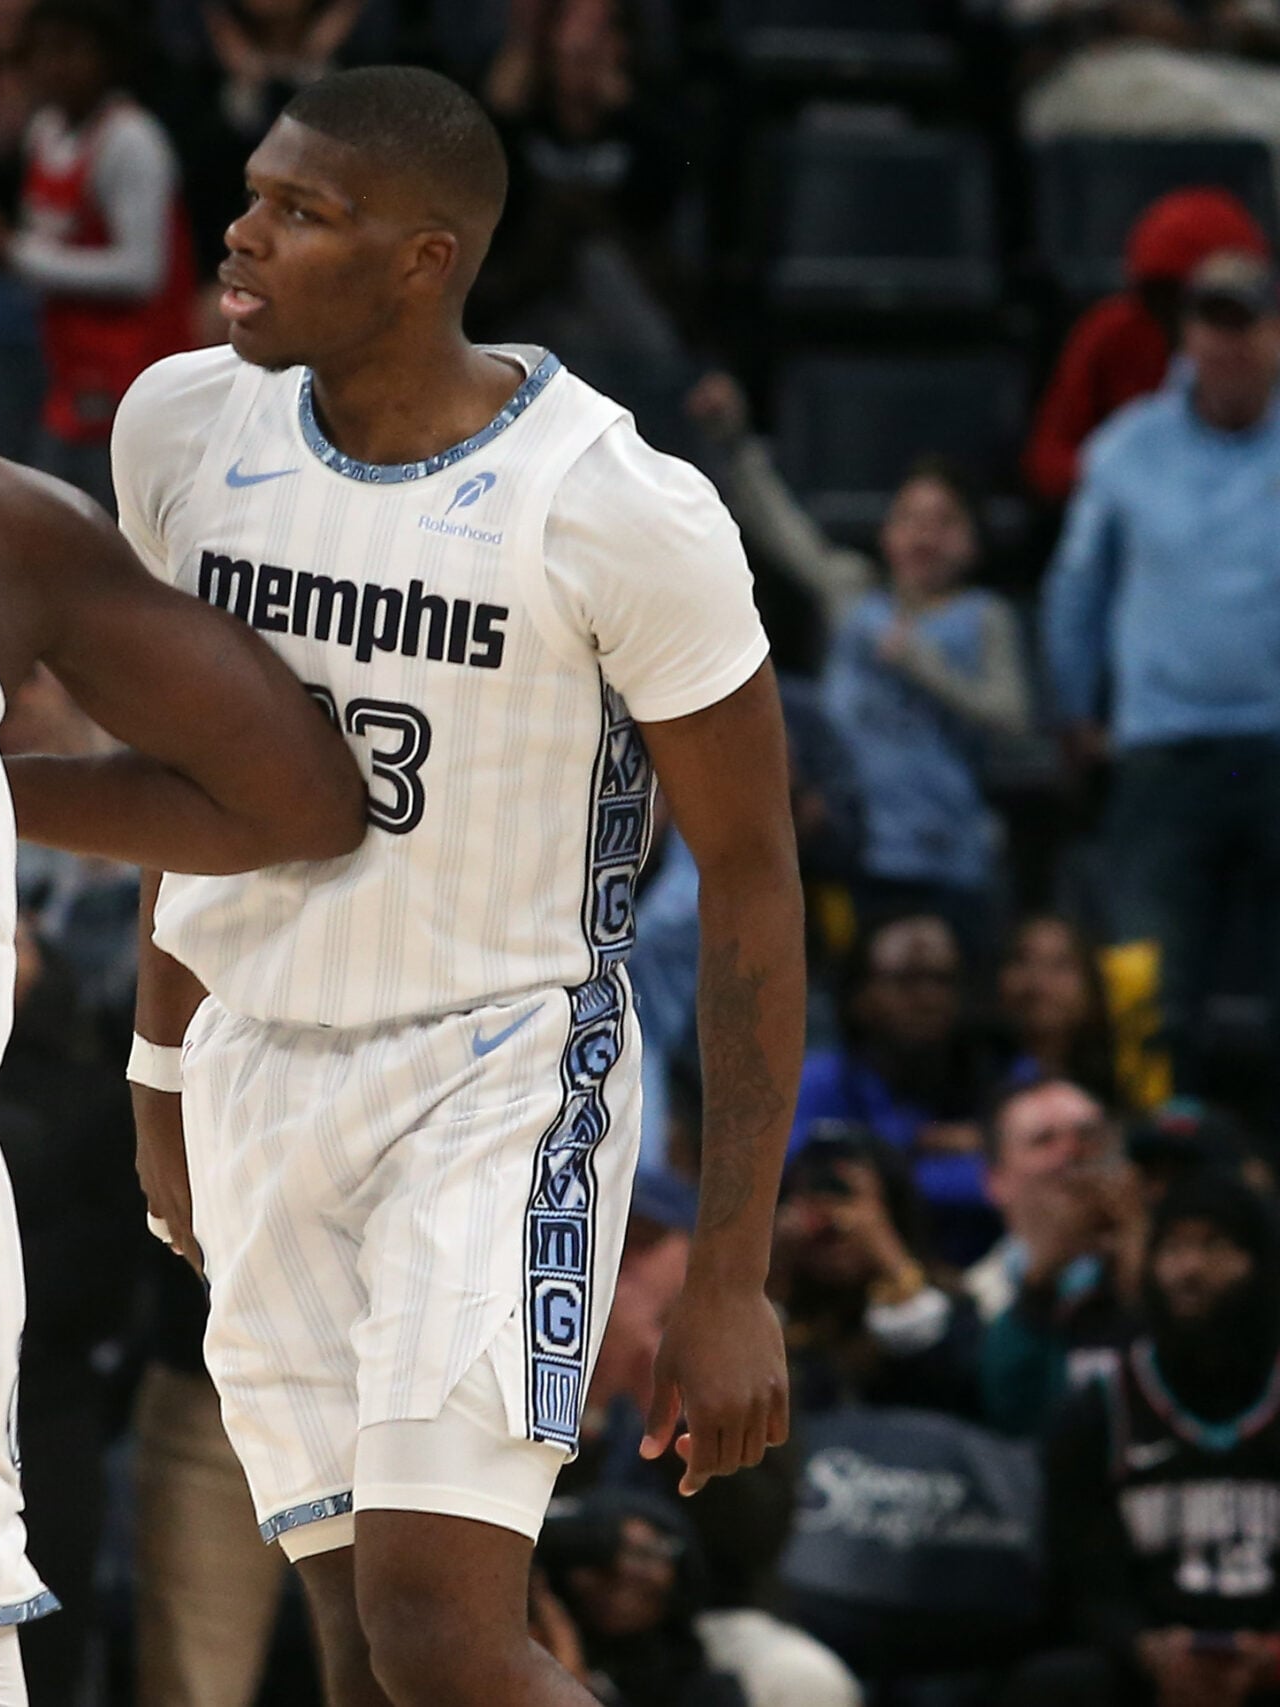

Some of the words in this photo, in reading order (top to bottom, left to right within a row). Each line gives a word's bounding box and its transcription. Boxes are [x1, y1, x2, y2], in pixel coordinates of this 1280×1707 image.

[418, 515, 503, 545] Robinhood
[198, 549, 510, 670] memphis
[303, 682, 432, 835] 3
